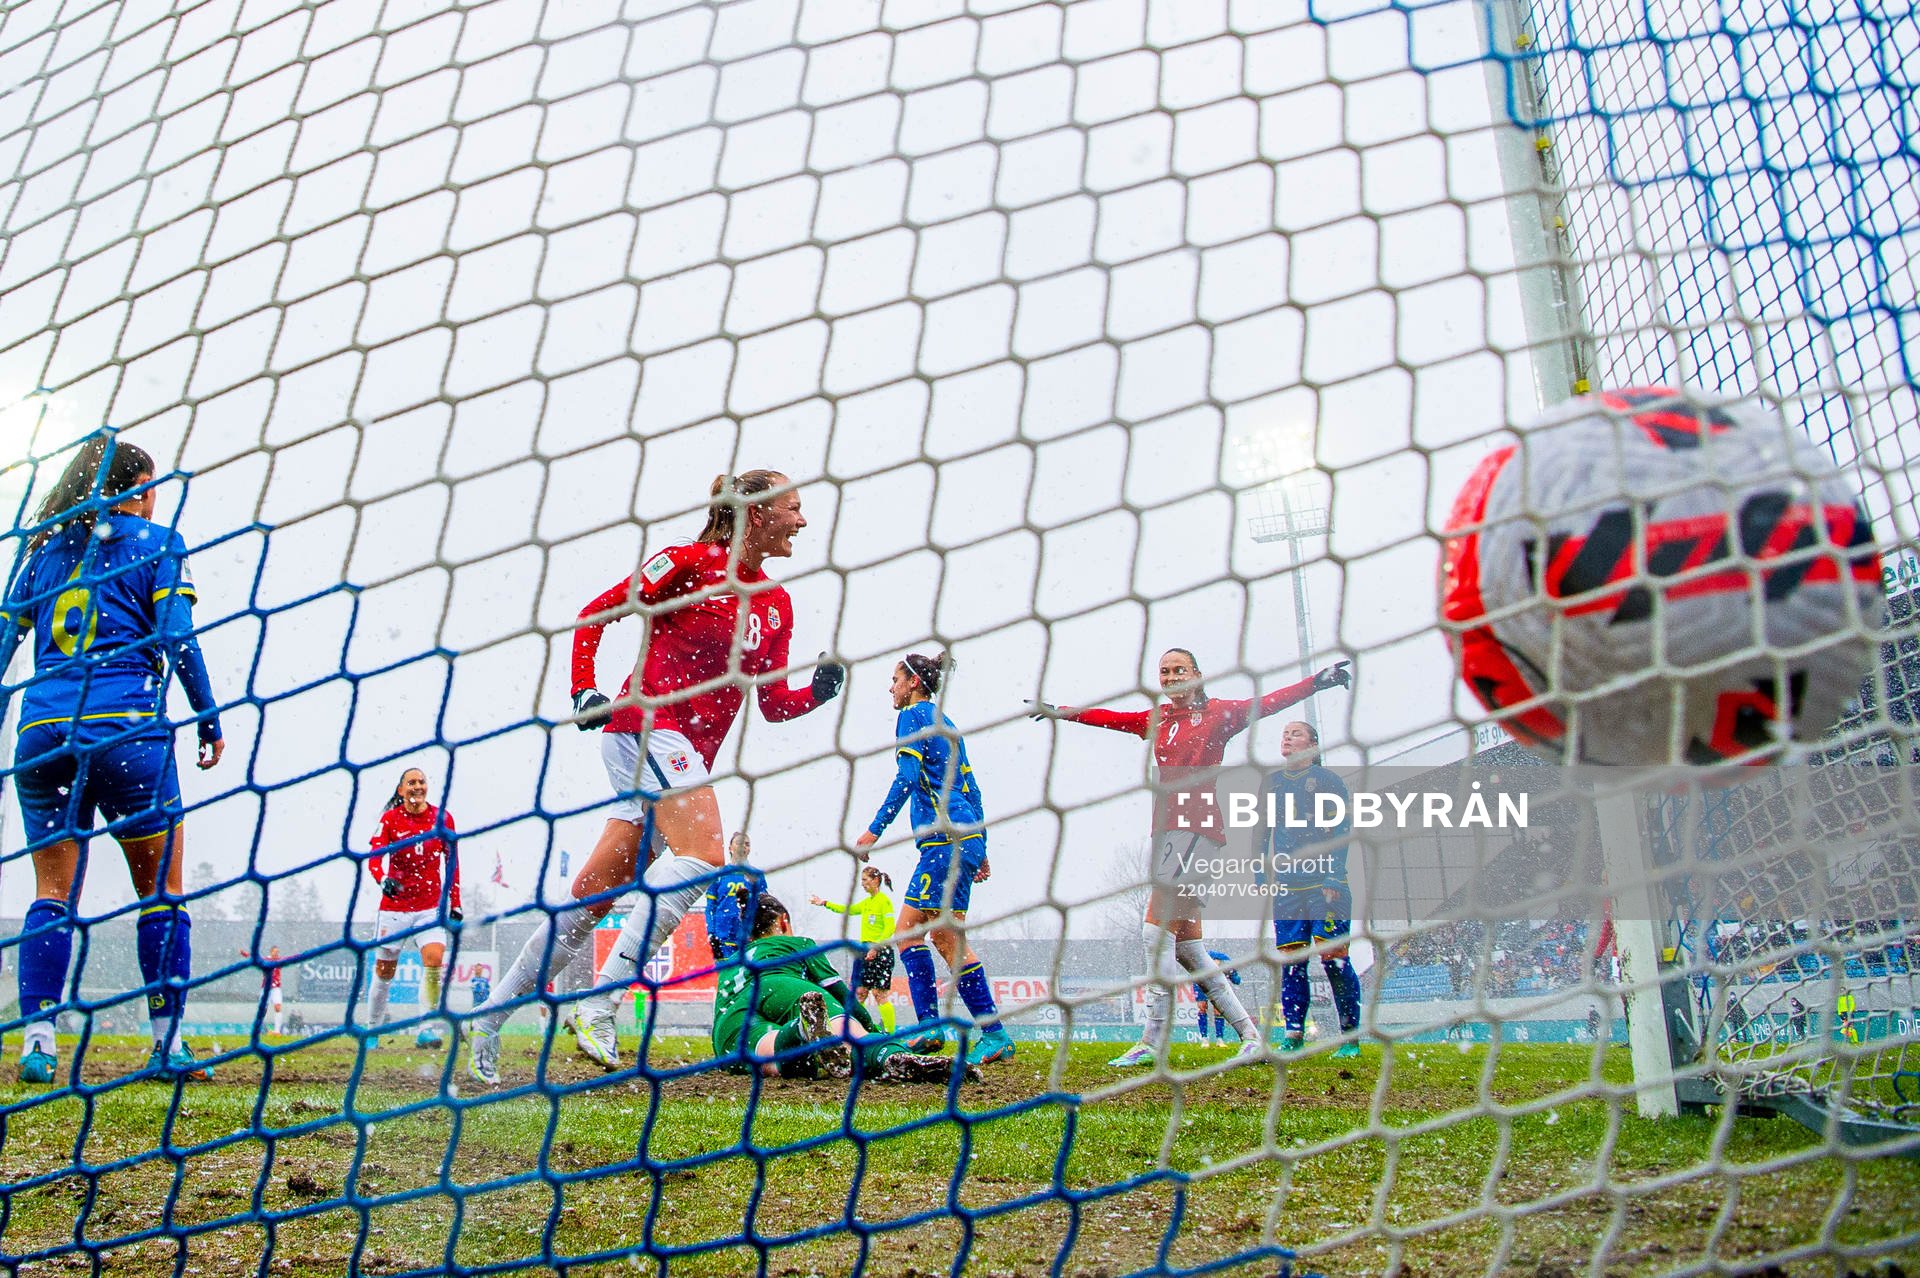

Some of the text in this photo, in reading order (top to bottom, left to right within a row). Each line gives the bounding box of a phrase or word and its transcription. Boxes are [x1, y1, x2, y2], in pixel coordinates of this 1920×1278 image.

[1167, 721, 1179, 745] 9
[919, 873, 932, 899] 2
[1324, 911, 1336, 933] 5
